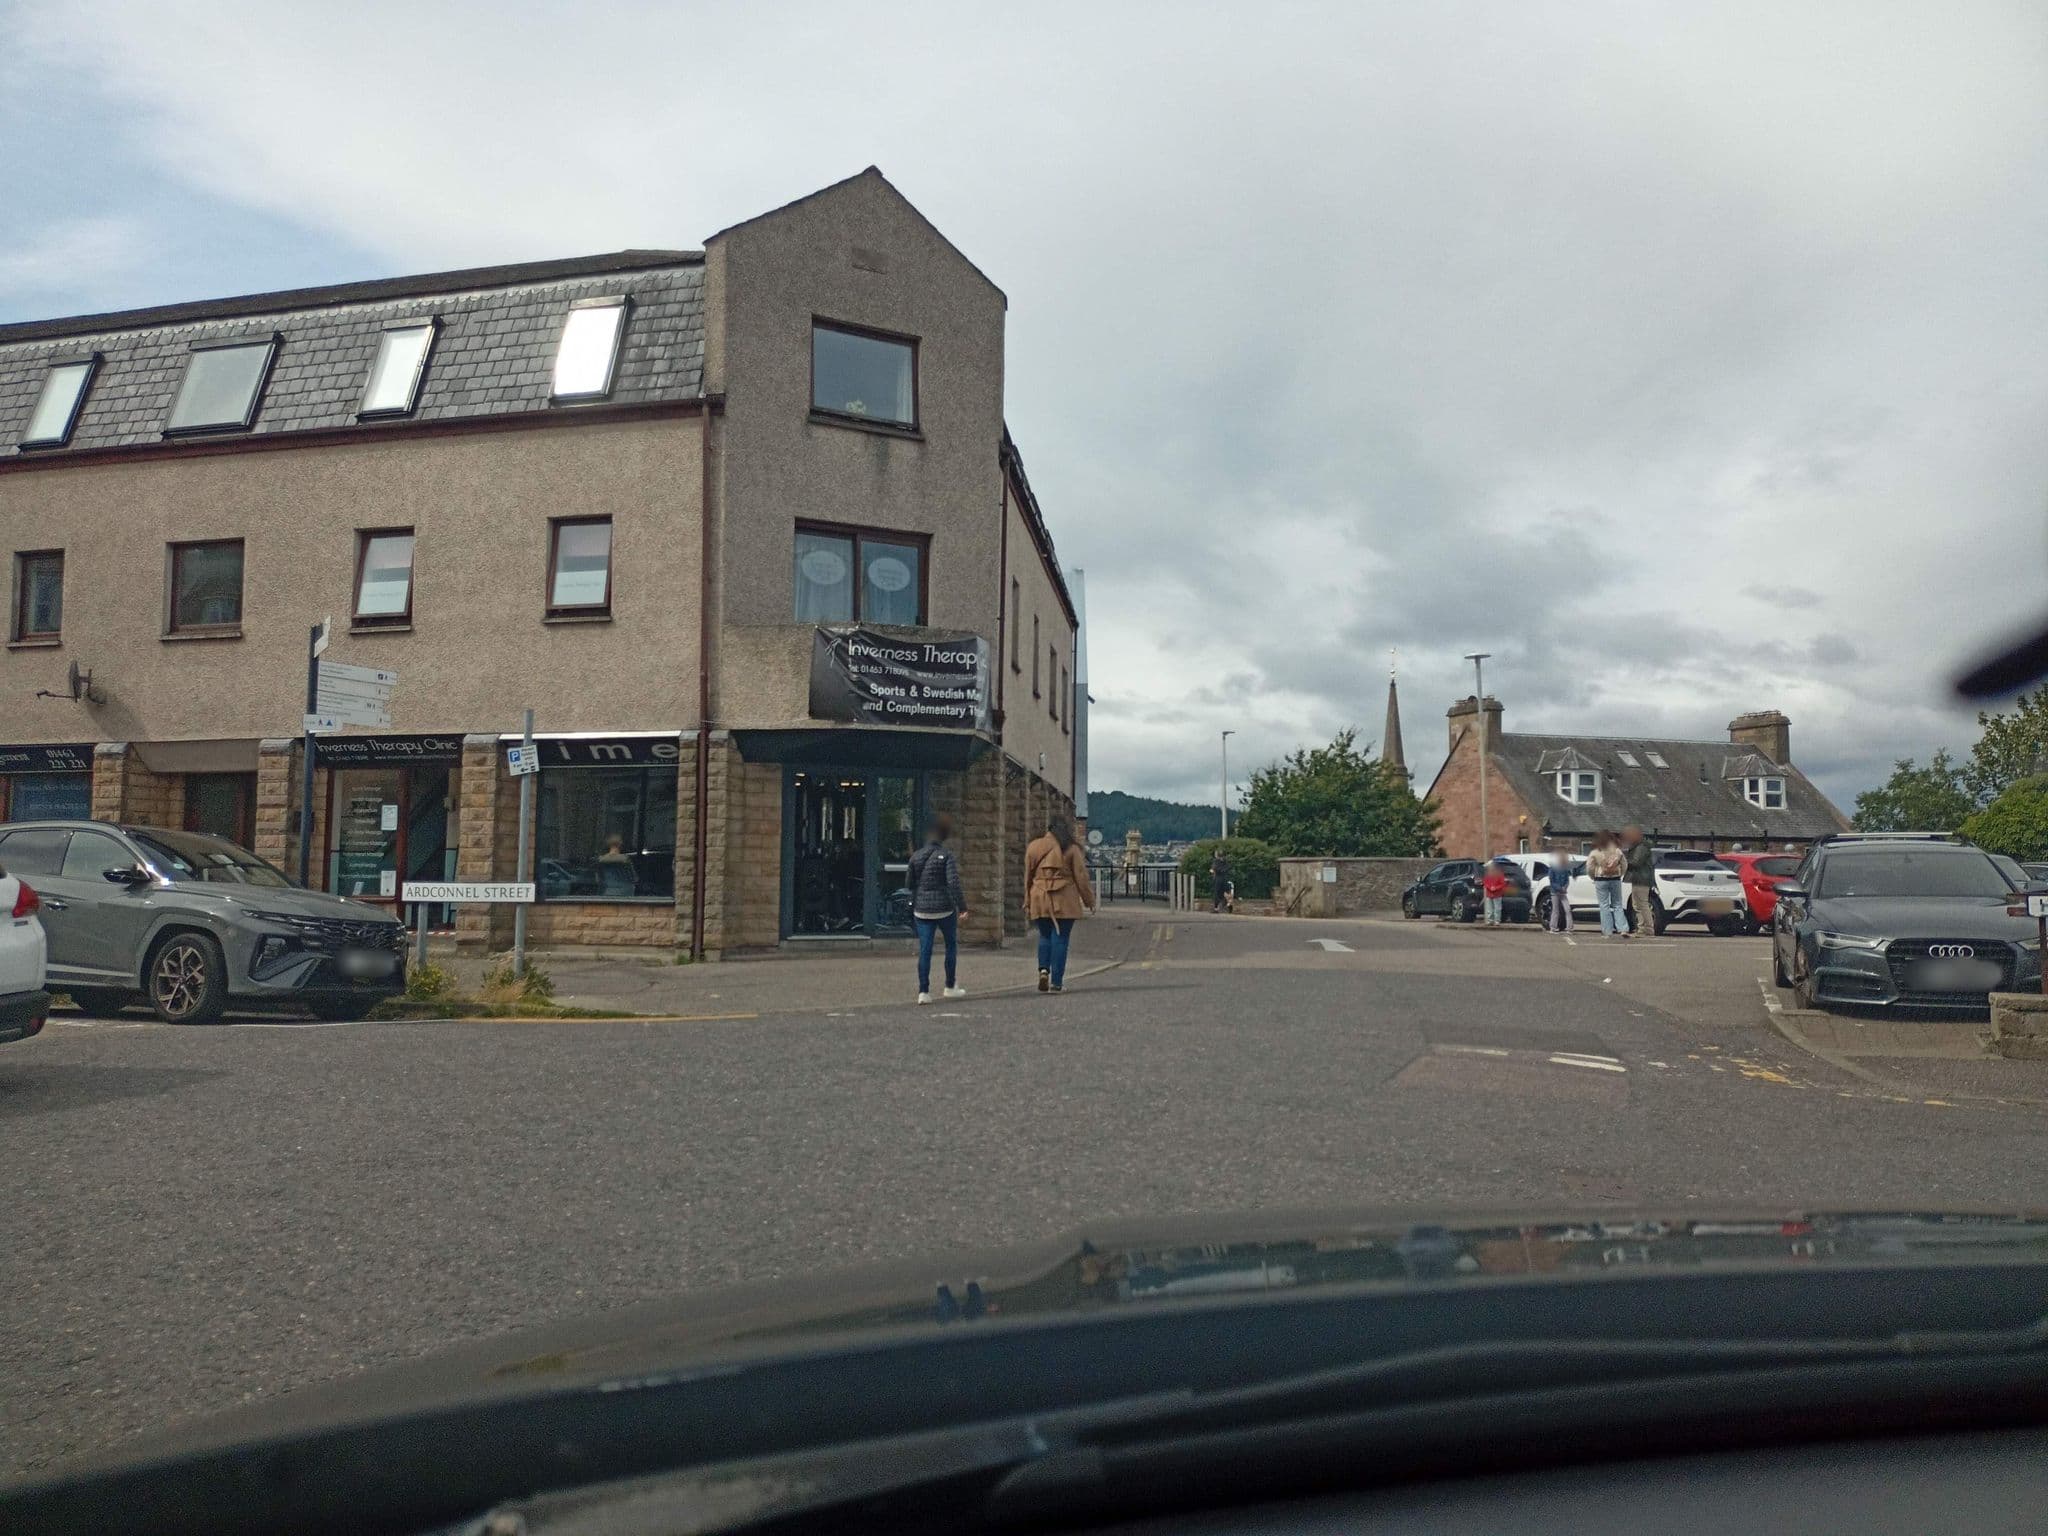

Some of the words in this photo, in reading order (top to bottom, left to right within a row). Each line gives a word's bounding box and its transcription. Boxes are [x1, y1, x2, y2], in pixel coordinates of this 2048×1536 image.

[849, 640, 918, 662] Inverness
[861, 665, 882, 674] 01463
[870, 683, 906, 698] Sports
[909, 685, 918, 698] &
[923, 686, 964, 700] Swedish
[863, 700, 882, 712] and
[887, 700, 966, 719] Complementary
[315, 741, 368, 752] Inverness
[367, 739, 423, 753] Therapy
[424, 739, 458, 750] Clinic
[48, 759, 66, 769] 221
[69, 759, 87, 768] 221
[406, 886, 479, 898] ARDCONNEL
[484, 887, 531, 898] STREET
